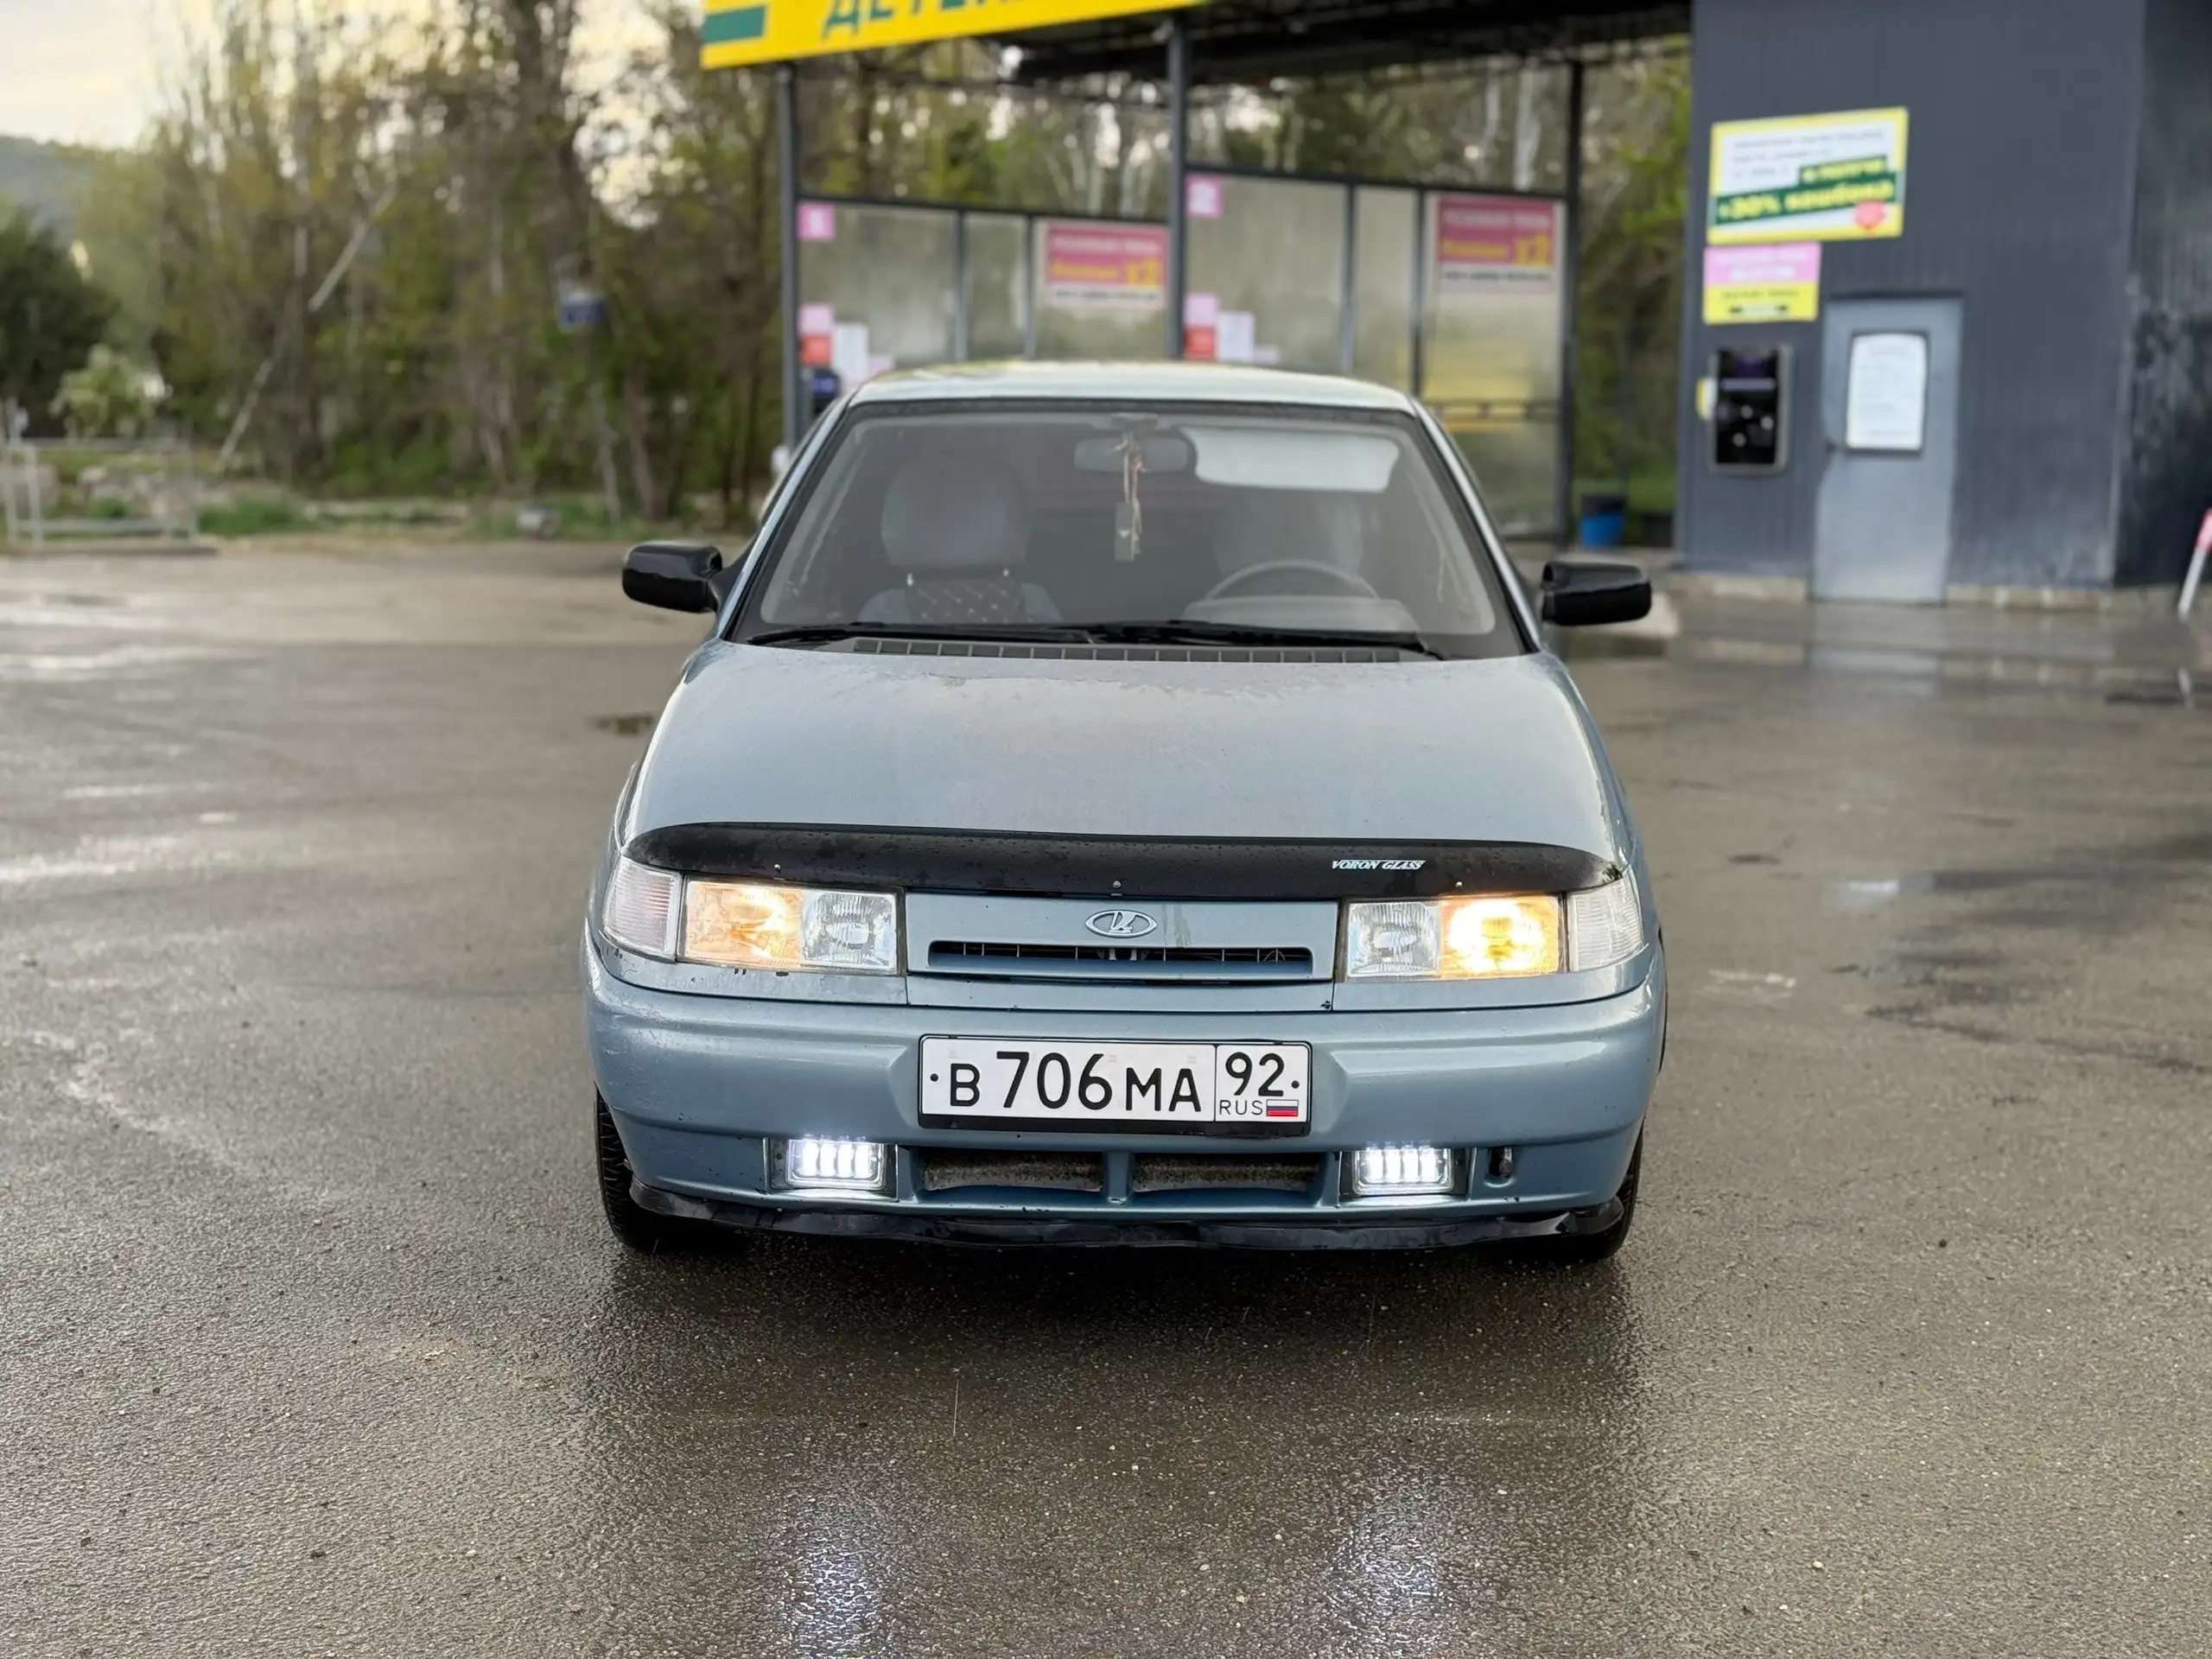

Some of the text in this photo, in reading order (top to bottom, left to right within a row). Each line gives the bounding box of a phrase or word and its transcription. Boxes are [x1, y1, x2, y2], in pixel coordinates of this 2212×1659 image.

[1332, 859, 1427, 870] VORON GLASS
[1224, 1052, 1285, 1097] 92
[1219, 1099, 1263, 1116] RUS
